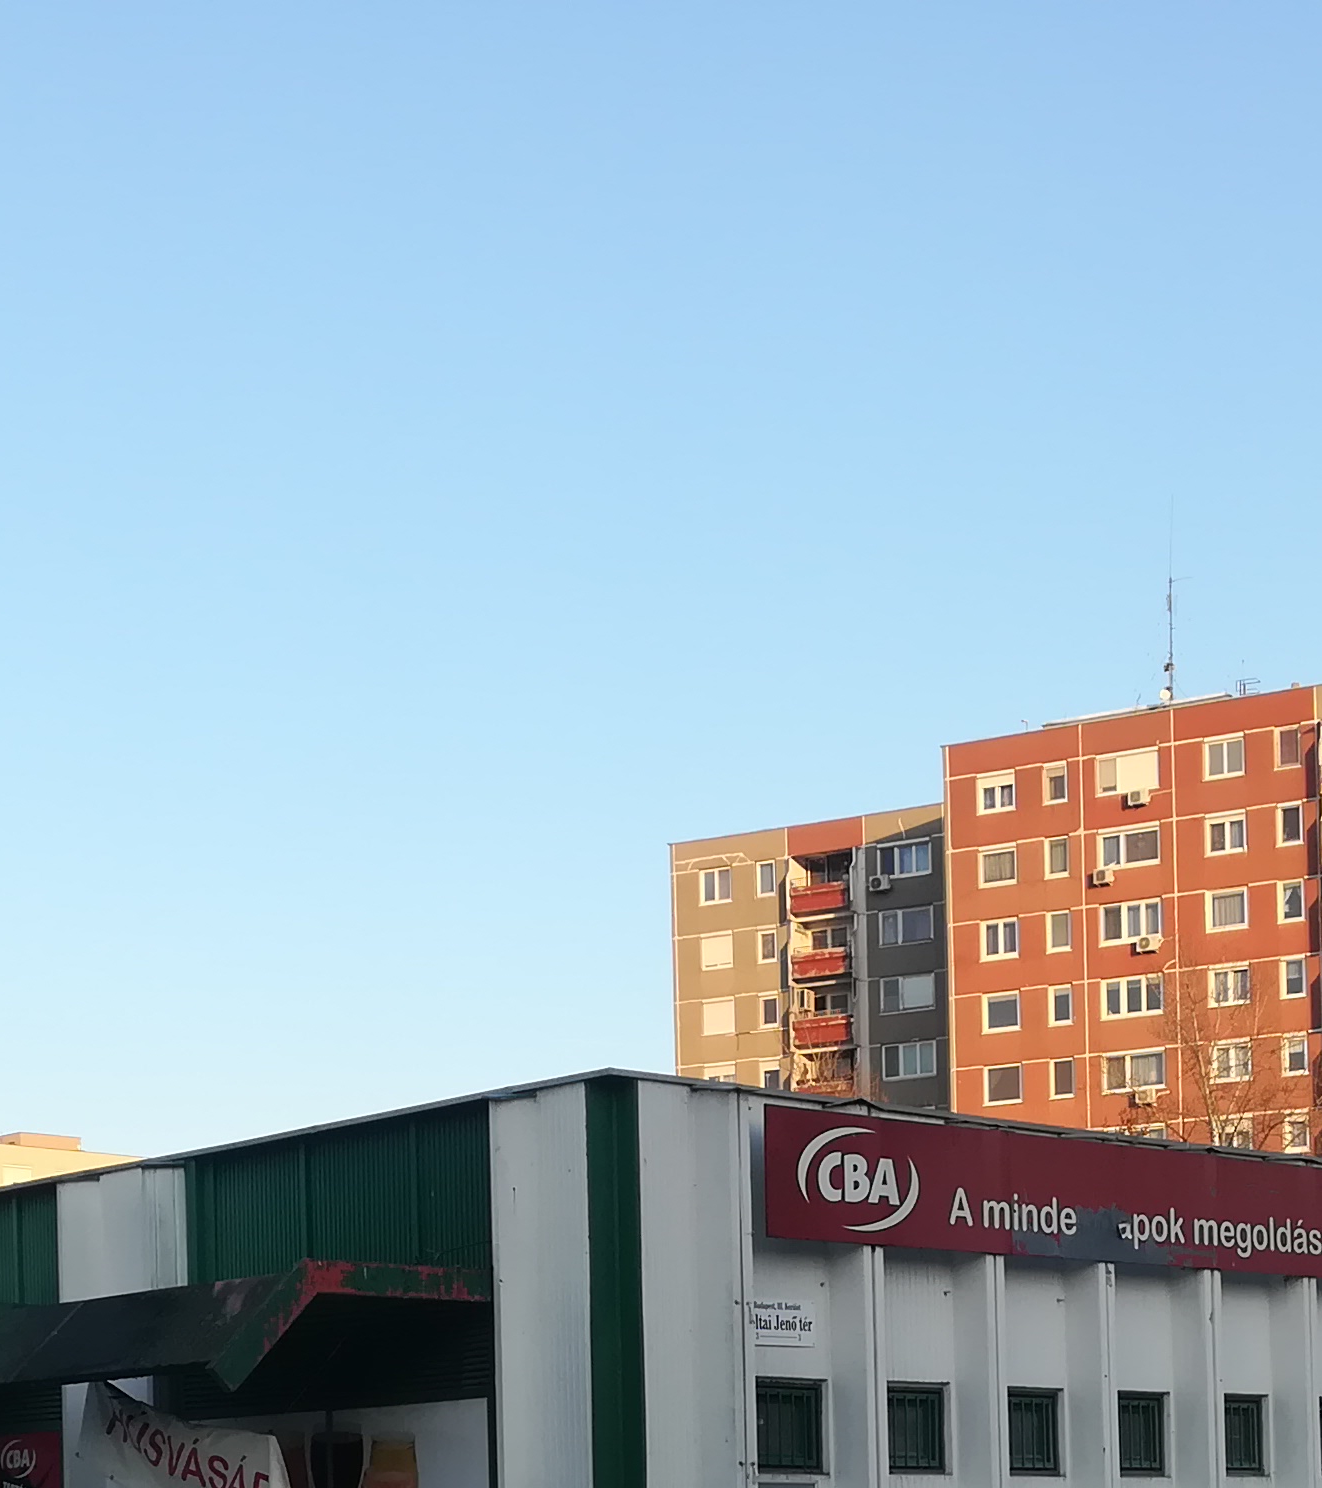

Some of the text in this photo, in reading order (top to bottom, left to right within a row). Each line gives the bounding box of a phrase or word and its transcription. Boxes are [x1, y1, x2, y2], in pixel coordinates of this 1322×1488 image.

[817, 1150, 901, 1206] CBA
[949, 1187, 974, 1227] A
[982, 1193, 1186, 1250] mindeapok
[774, 1314, 797, 1331] Jenő
[799, 1316, 813, 1332] tér
[6, 1449, 31, 1469] CBA
